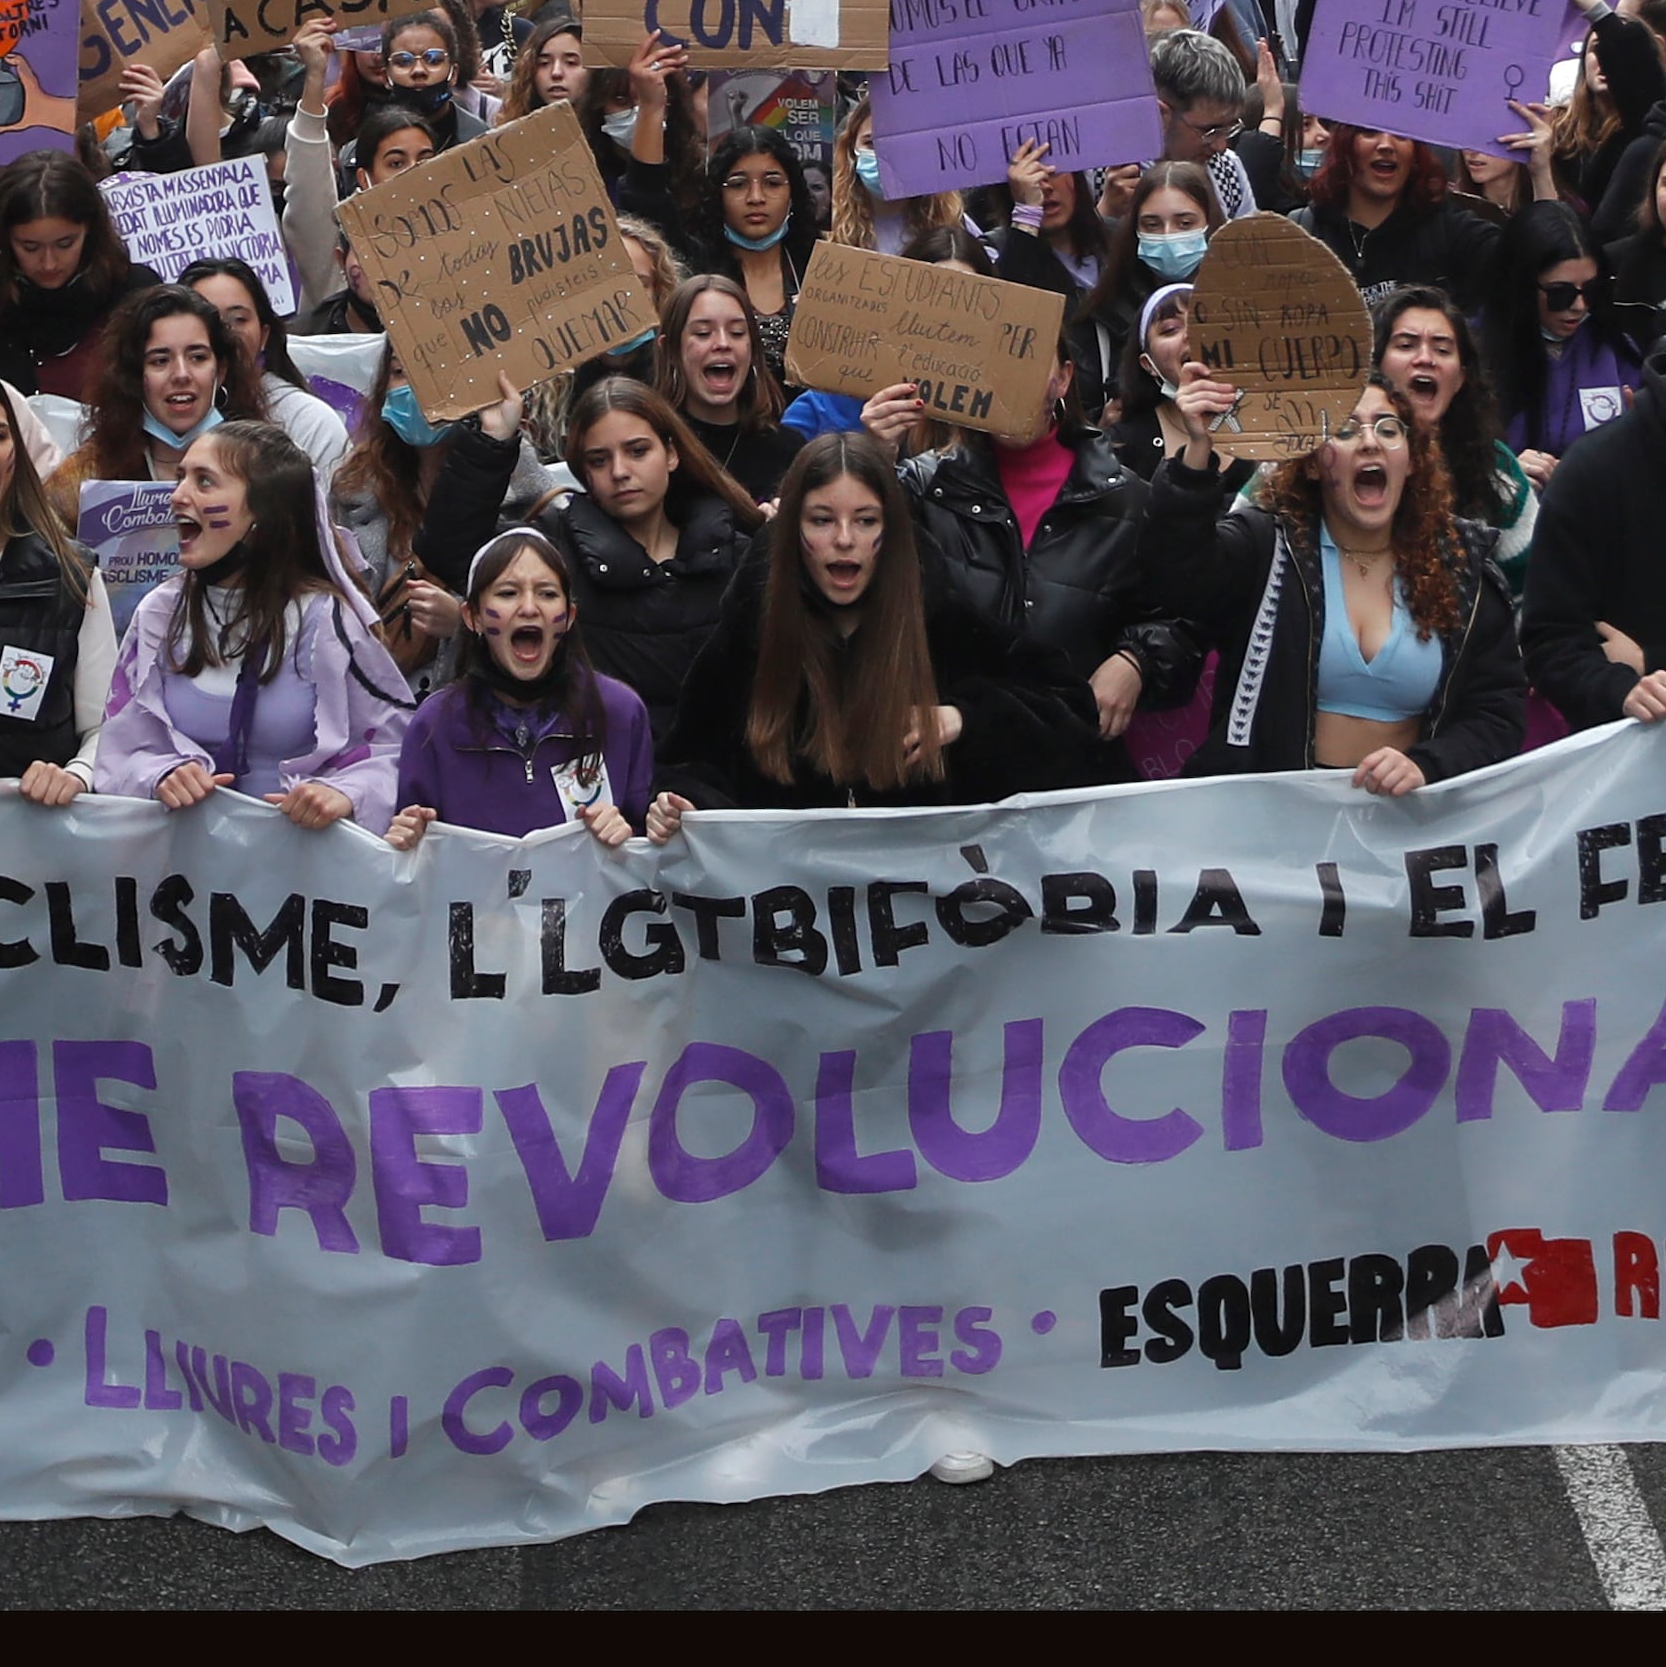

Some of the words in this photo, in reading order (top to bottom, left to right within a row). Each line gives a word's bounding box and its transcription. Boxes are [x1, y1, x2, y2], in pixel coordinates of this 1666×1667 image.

[1337, 21, 1468, 80] PROTESTING
[1433, 4, 1493, 50] STILL
[935, 48, 981, 87] LAS
[990, 39, 1035, 79] QUE
[1042, 34, 1068, 72] YA
[776, 97, 819, 110] VOLEM
[1362, 67, 1403, 104] THIS
[1413, 80, 1459, 115] SHIT
[787, 110, 820, 124] SER
[794, 130, 822, 142] QUE
[461, 133, 517, 184] LAS
[937, 132, 978, 173] NO
[237, 184, 262, 208] QUE
[493, 160, 587, 225] NIETAS
[507, 205, 609, 286] BRUJAS
[858, 256, 1003, 322] ESTUDIANTS
[459, 302, 512, 357] NO
[532, 289, 642, 371] QUEMAR
[796, 314, 881, 361] CONSTRUIR
[997, 322, 1038, 360] PER
[1200, 338, 1233, 369] MI
[1257, 334, 1361, 383] CUERPO
[108, 556, 133, 567] PROU
[1317, 862, 1346, 938] I
[1404, 841, 1536, 940] EL
[83, 1304, 358, 1467] LLIURES
[389, 1394, 408, 1459] I
[441, 1302, 1004, 1456] COMBATIVES
[1099, 1244, 1505, 1370] ESQUERRA
